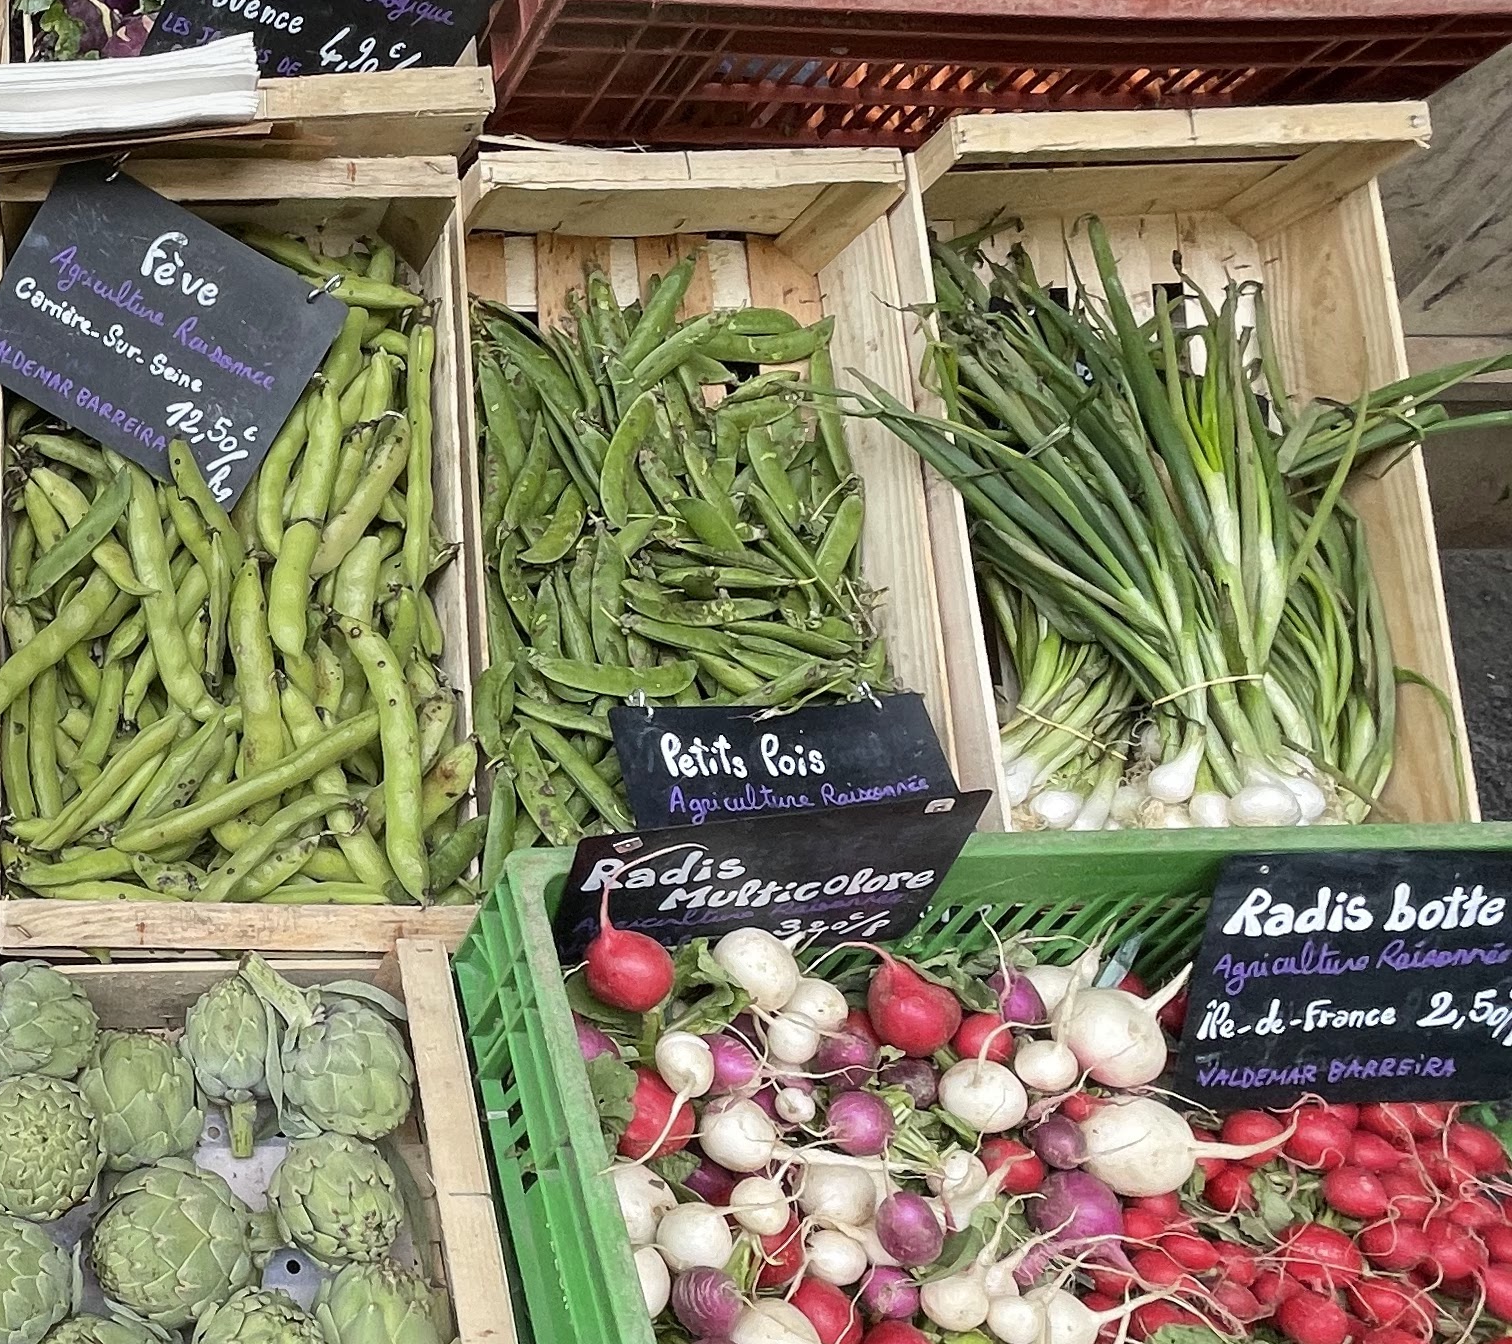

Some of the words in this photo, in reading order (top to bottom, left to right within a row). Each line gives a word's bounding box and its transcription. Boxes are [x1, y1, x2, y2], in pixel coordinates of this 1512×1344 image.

[162, 11, 190, 35] LES
[50, 245, 166, 327] Agriculture
[140, 231, 219, 307] Fève
[660, 732, 748, 779] Petits
[760, 731, 827, 778] Pois
[668, 783, 815, 825] Agriculture
[580, 849, 748, 893] Radis
[657, 867, 936, 913] Multicolore
[1222, 886, 1374, 937] Radis
[1383, 882, 1506, 932] botte
[1213, 940, 1370, 997] Agriculture
[1196, 1064, 1317, 1088] VALDEMAR
